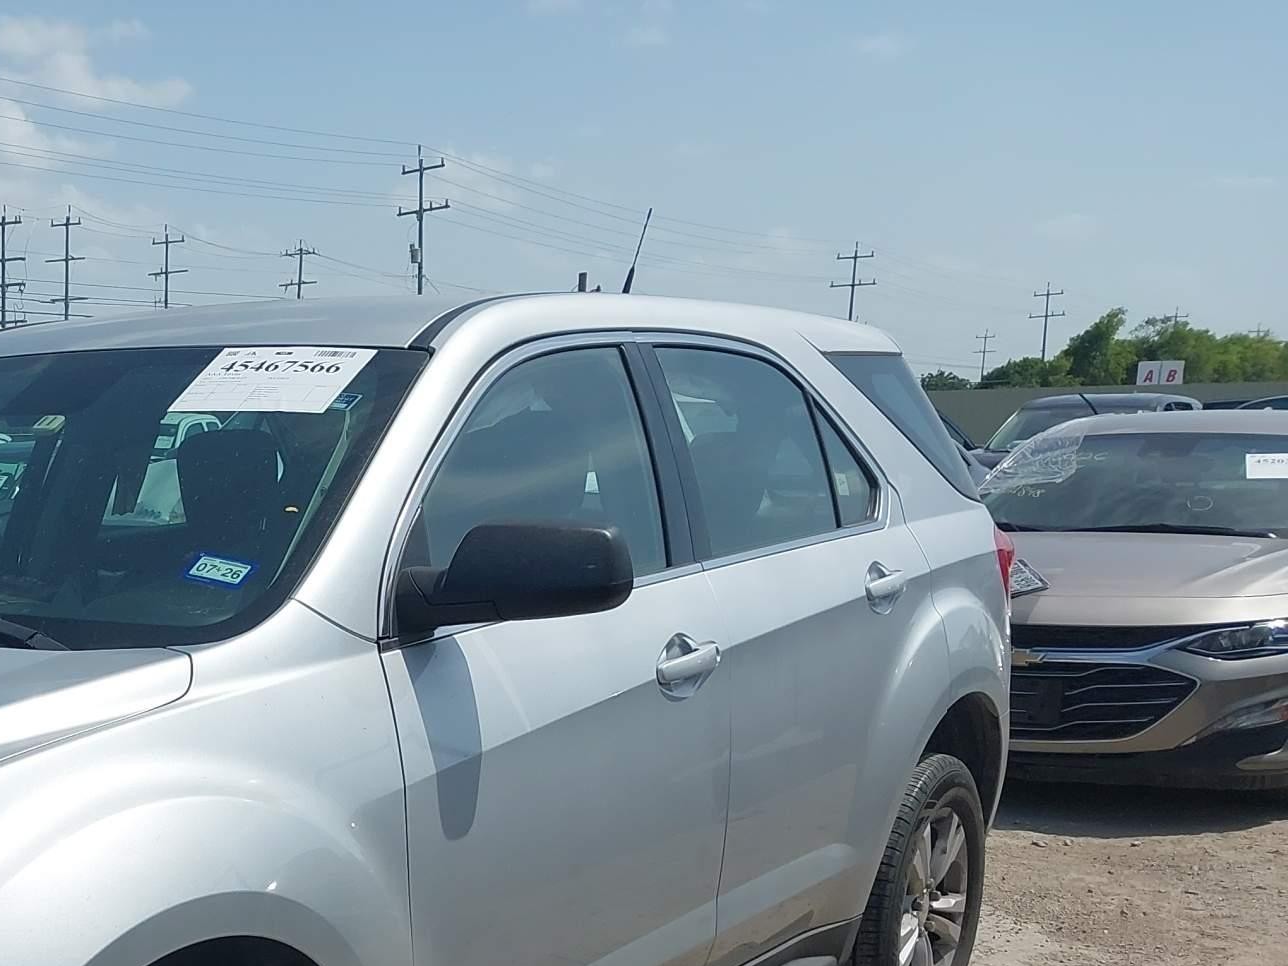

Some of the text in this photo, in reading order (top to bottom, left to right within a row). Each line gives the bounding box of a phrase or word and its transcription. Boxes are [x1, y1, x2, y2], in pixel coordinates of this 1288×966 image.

[220, 359, 343, 374] 45467566
[1143, 369, 1178, 383] A B
[196, 562, 219, 574] 07
[220, 567, 244, 580] 26
